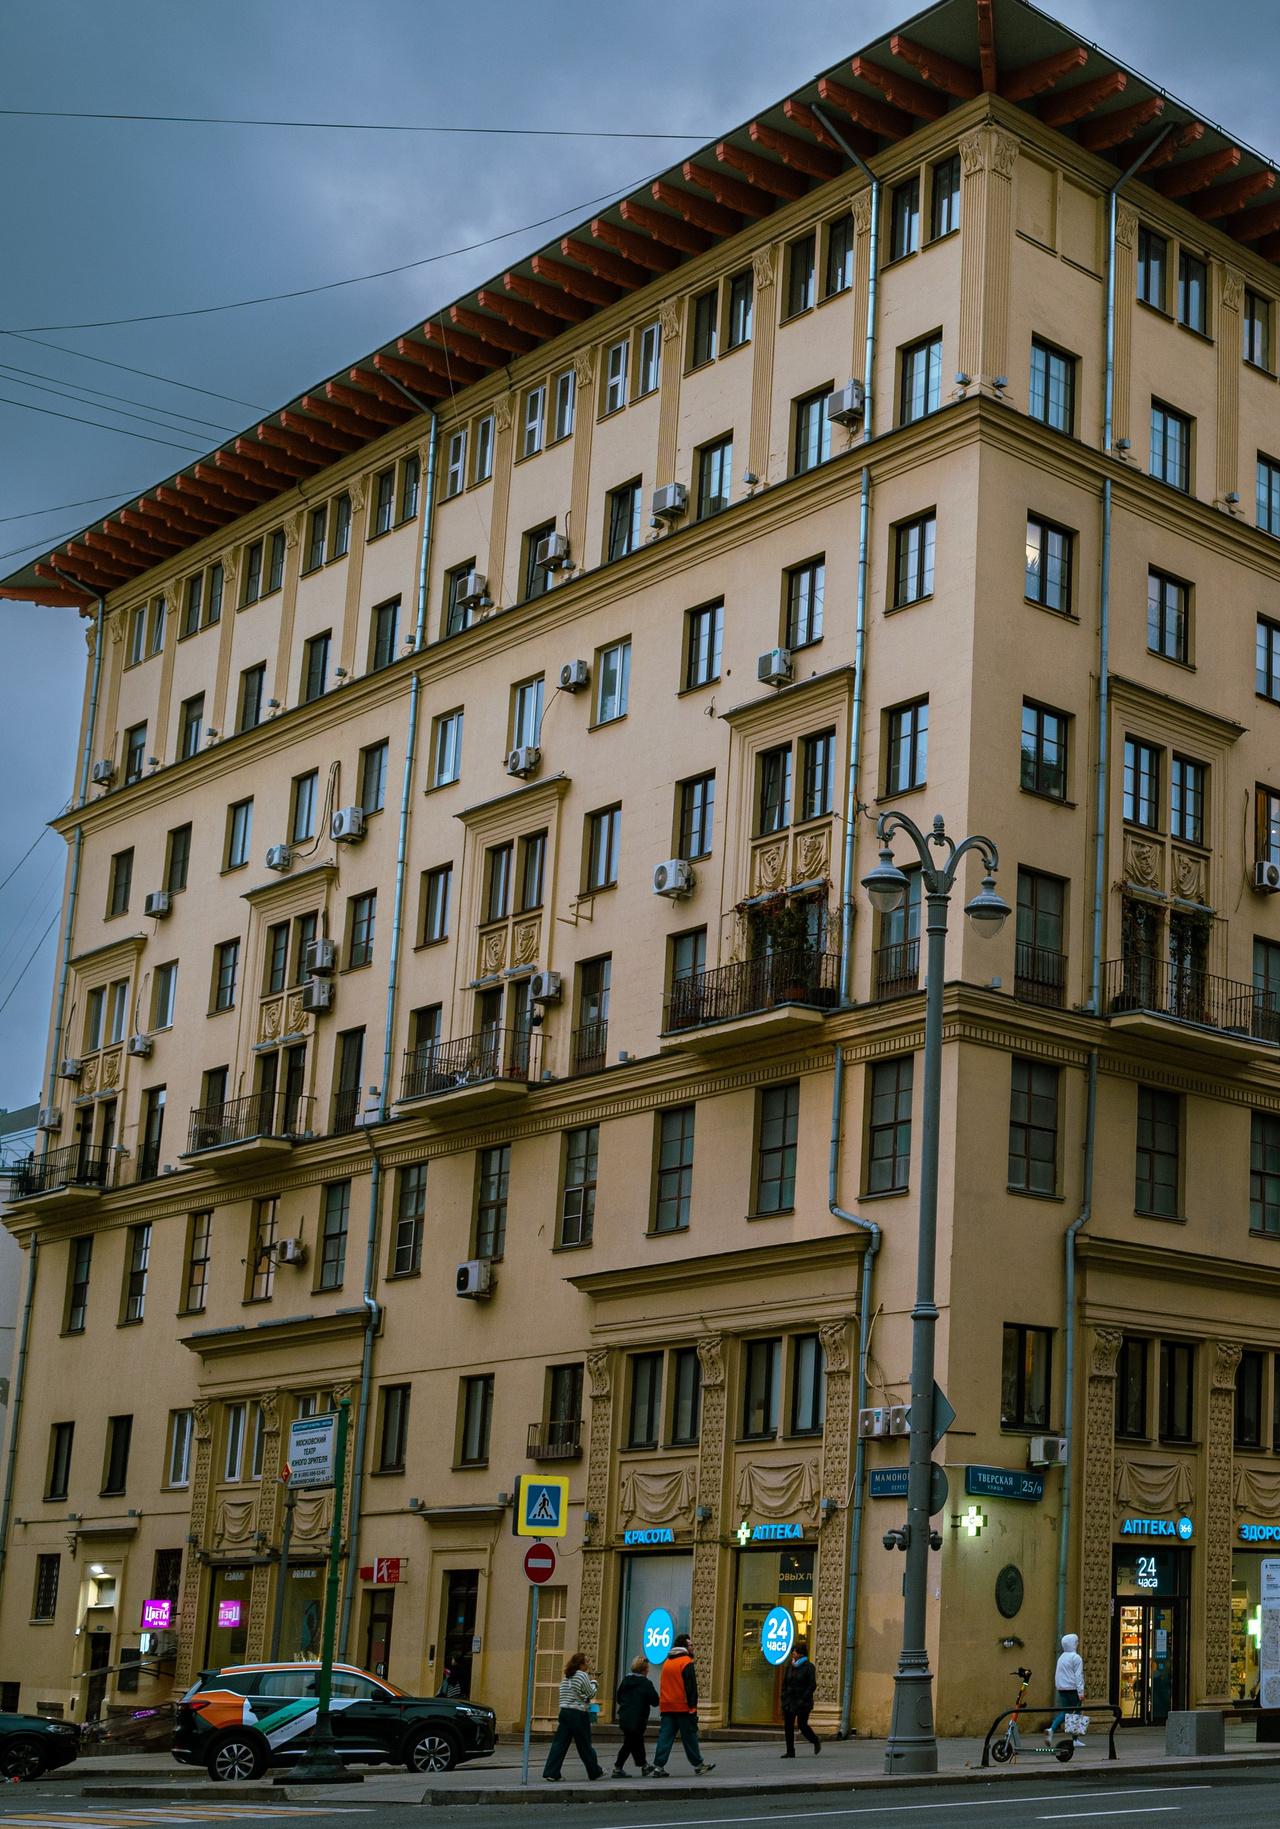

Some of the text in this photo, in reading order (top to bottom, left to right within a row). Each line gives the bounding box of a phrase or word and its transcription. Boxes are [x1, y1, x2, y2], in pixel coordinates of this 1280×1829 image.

[296, 1434, 327, 1447] МОСКОВСКИЙ
[303, 1447, 317, 1456] ТЕАТР
[291, 1455, 328, 1467] ЮНОГО ЗРИТЕЛЯ
[977, 1472, 1042, 1495] ТВЕРСКАЯ 25/9
[752, 1523, 802, 1540] АПТЕКА
[1123, 1518, 1177, 1536] АПТЕКА
[624, 1528, 674, 1544] КРАСОТА
[1138, 1557, 1157, 1577] 24
[1138, 1578, 1158, 1588] часа
[767, 1617, 788, 1639] 24
[766, 1641, 787, 1652] часа
